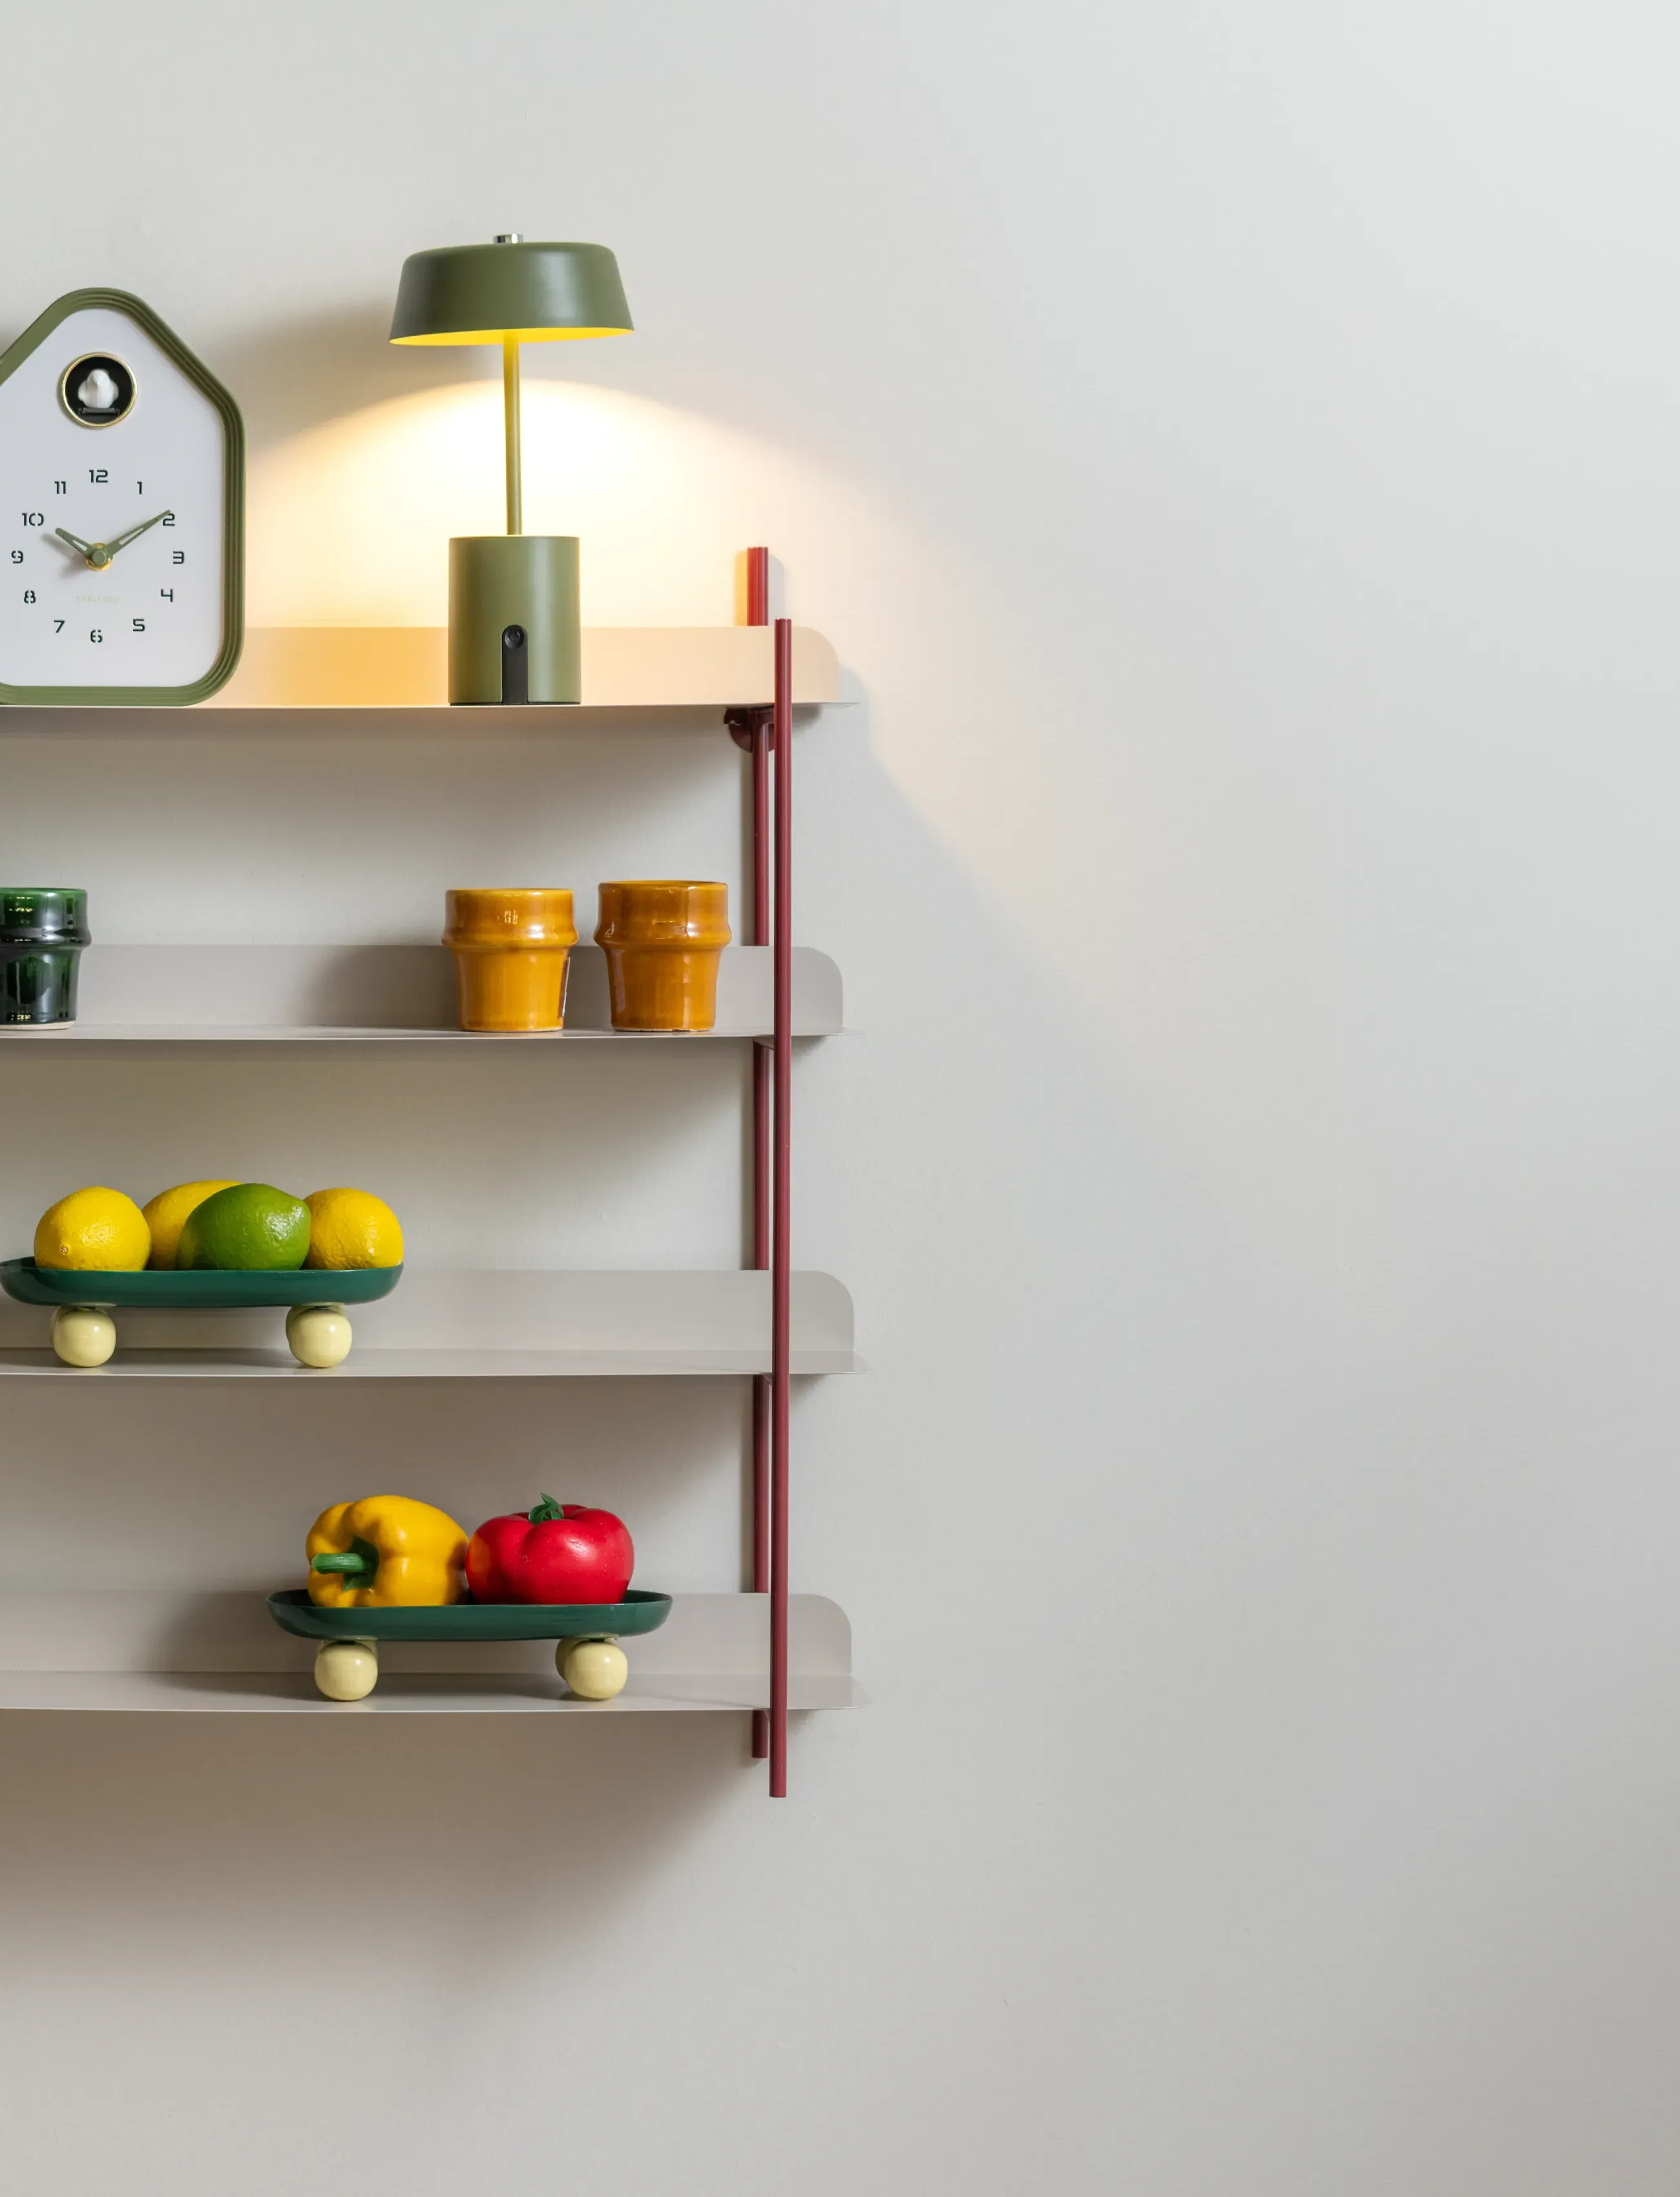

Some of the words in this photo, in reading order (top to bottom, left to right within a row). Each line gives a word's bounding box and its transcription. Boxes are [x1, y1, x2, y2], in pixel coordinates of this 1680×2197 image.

[89, 470, 108, 483] 12
[54, 481, 66, 494] 11
[137, 481, 142, 494] 1
[22, 512, 44, 526] 10
[162, 513, 175, 526] 2
[11, 551, 23, 563] 9
[173, 551, 184, 564] 3
[24, 590, 36, 604] 8
[160, 589, 173, 602] 4
[54, 620, 65, 633] 7
[132, 618, 145, 632] 5
[90, 629, 103, 643] 6
